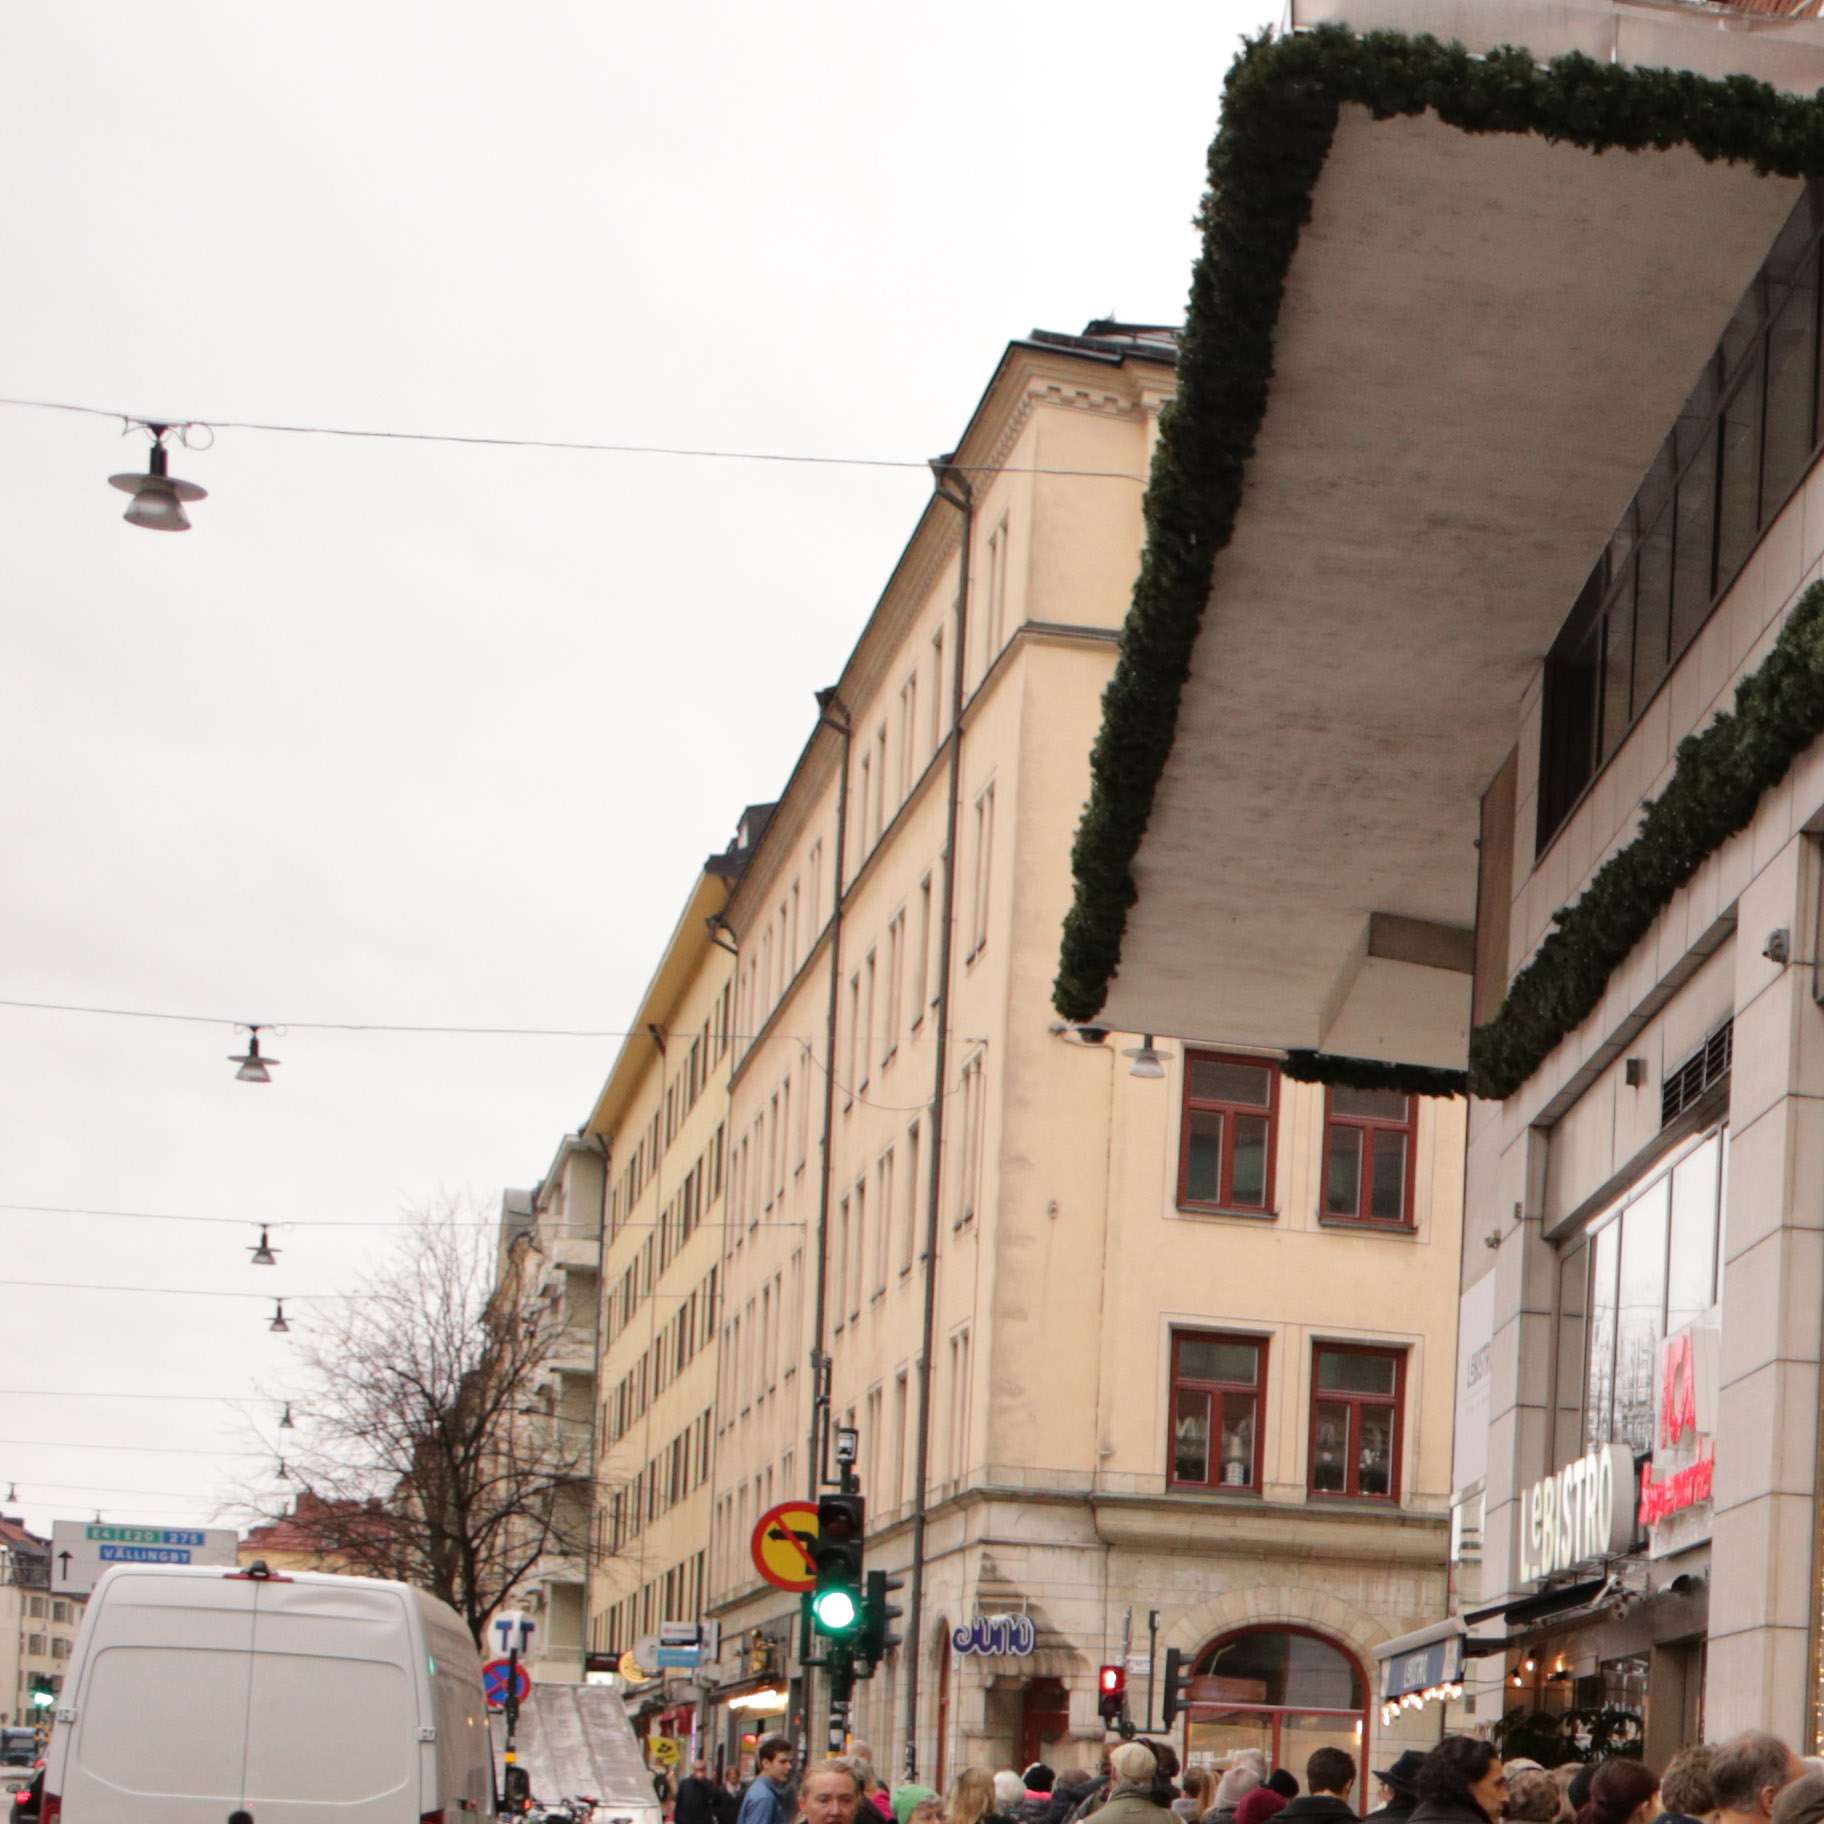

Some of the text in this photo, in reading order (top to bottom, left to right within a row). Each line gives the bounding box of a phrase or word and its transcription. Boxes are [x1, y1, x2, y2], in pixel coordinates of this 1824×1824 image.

[91, 1527, 111, 1540] E4
[125, 1529, 155, 1542] E20
[102, 1546, 190, 1563] VÄLLINGBY
